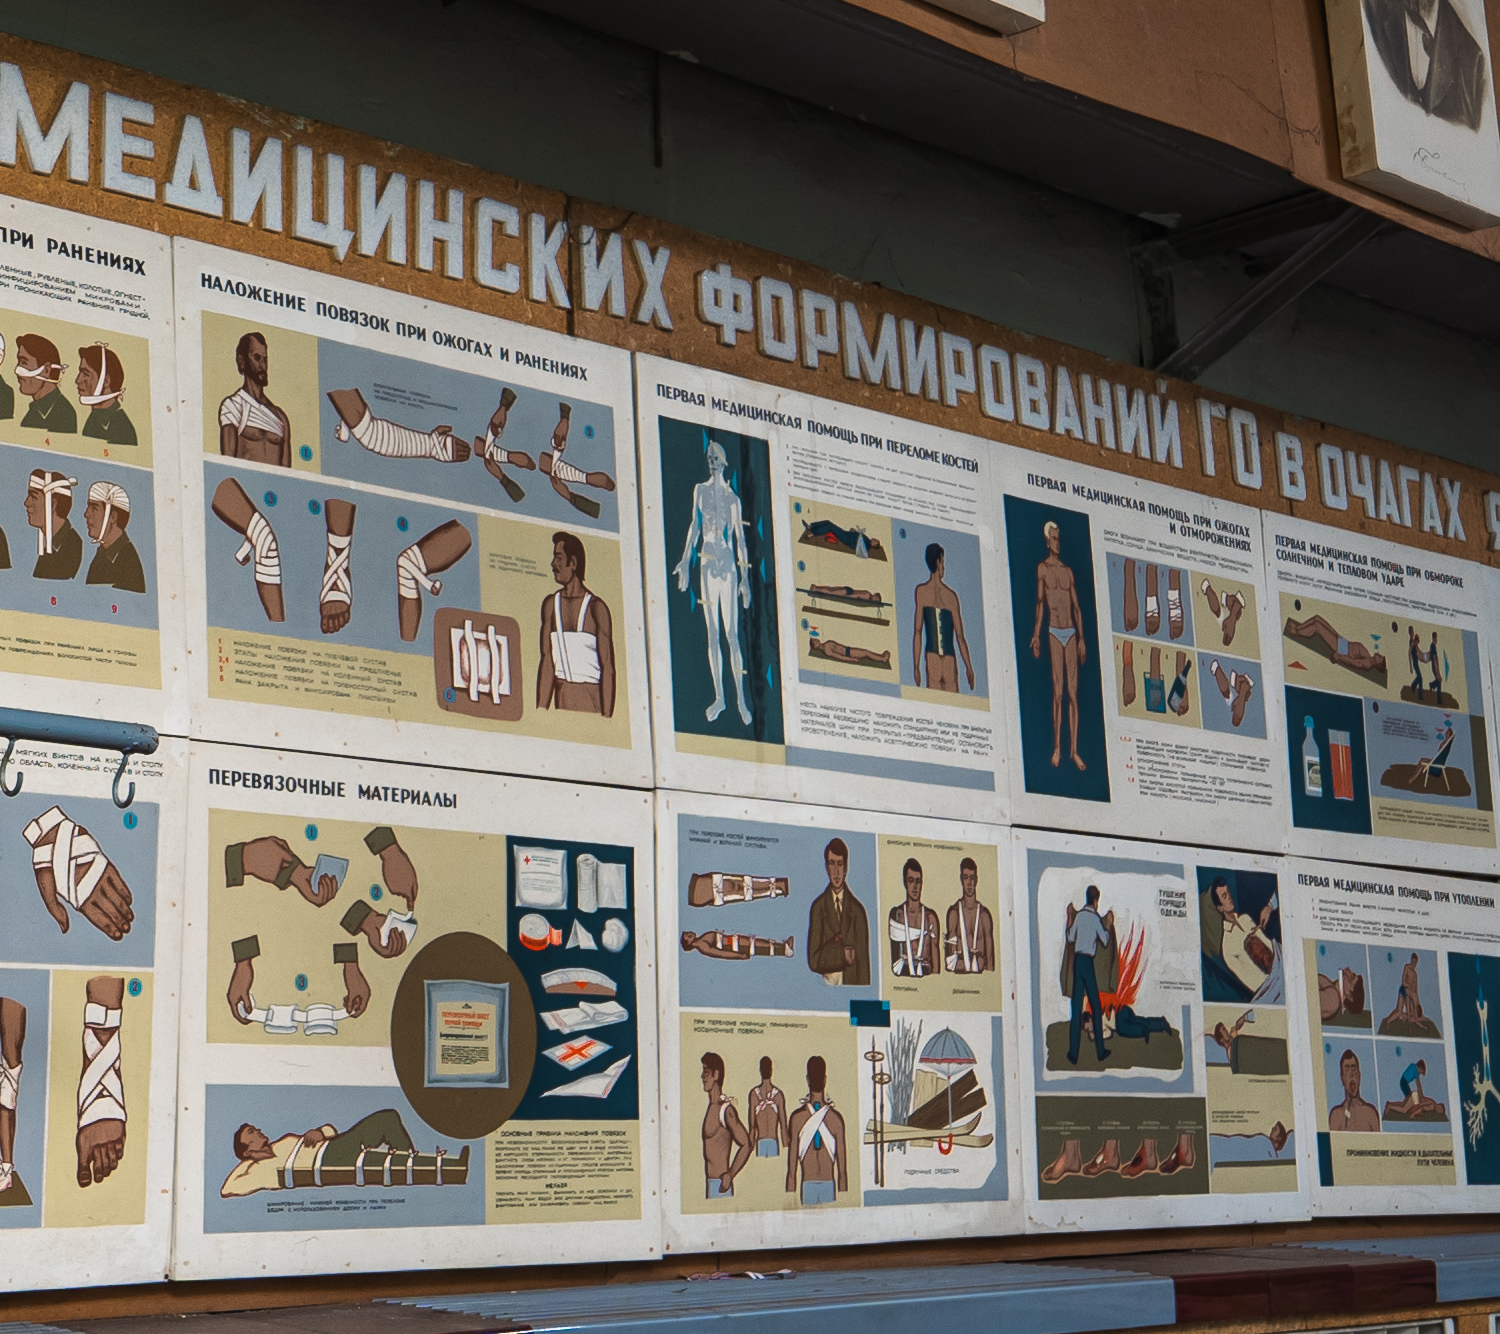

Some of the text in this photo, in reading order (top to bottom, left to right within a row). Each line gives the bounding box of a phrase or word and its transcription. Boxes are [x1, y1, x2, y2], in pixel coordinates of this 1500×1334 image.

[46, 237, 146, 276] РАНЕНИЯХ
[201, 272, 588, 382] НАЛОЖЕНИЕ ПОВЯЗОК ПРИ ОЖОГАХ И РАНЕНИЯХ
[656, 383, 979, 474] ПЕРВАЯ МЕДИЦИНСКАЯ ПОМОЩЬ ПРИ ПЕРЕЛОМЕ КОСТЕЙ
[700, 262, 1183, 469] ФОРМИРОВАНИЙ
[1197, 397, 1262, 491] ГО
[1277, 431, 1306, 501] В
[1319, 442, 1467, 541] ОЧАГАХ
[1027, 472, 1251, 539] ПЕРВАЯ МЕДИЦИНСКАЯ ПОМОЩЬ ПРИ ОЖОГАХ
[1169, 522, 1177, 535] И
[1179, 524, 1252, 553] ОТМОРОЖЕНИЯХ
[209, 768, 457, 809] ПЕРЕВЯЗОЧНЫЕ МАТЕРИАЛЫ
